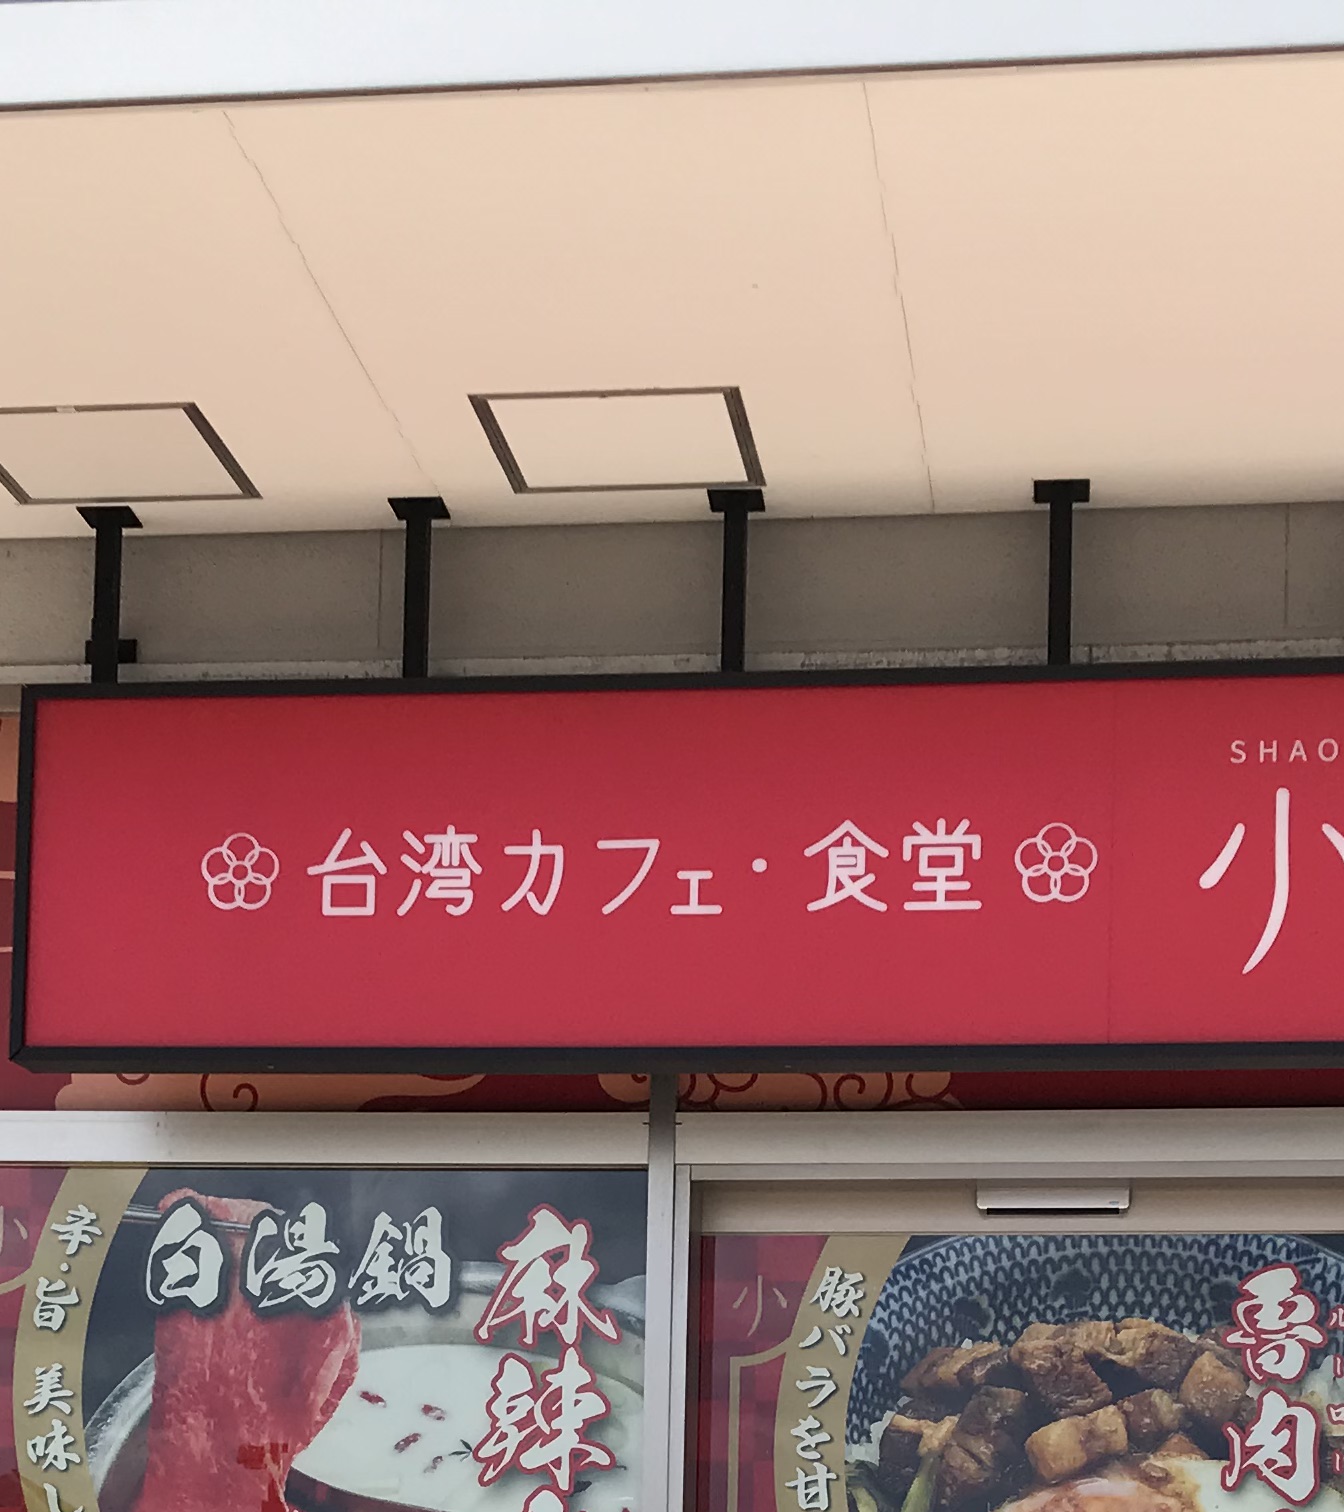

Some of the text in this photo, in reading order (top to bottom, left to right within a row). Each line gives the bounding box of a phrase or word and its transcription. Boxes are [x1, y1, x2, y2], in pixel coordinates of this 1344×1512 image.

[1229, 739, 1341, 765] SHAO
[306, 818, 982, 917] 台湾カフェ・食堂
[144, 1200, 453, 1312] 白湯鍋
